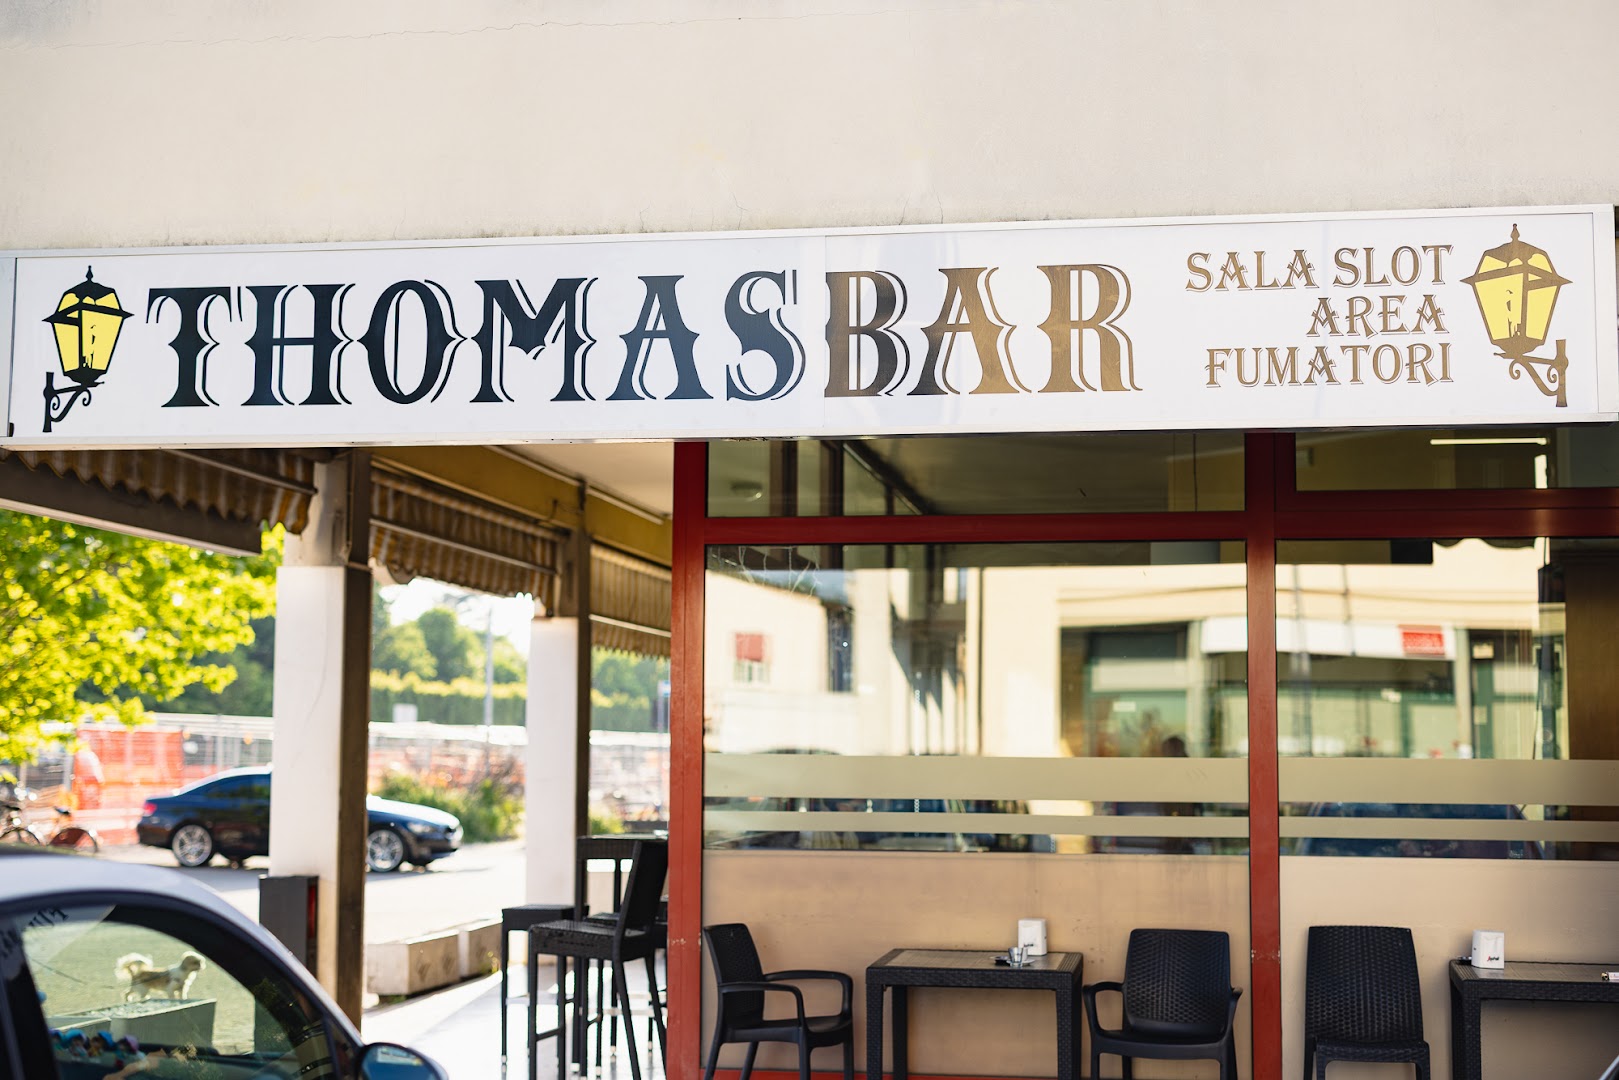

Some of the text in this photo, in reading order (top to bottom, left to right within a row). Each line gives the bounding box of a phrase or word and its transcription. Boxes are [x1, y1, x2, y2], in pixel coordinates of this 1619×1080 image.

[1186, 245, 1452, 290] SALA SLOT
[146, 264, 1143, 407] THOMAS BAR
[1307, 295, 1448, 337] AREA
[1205, 343, 1453, 387] FUMATORI
